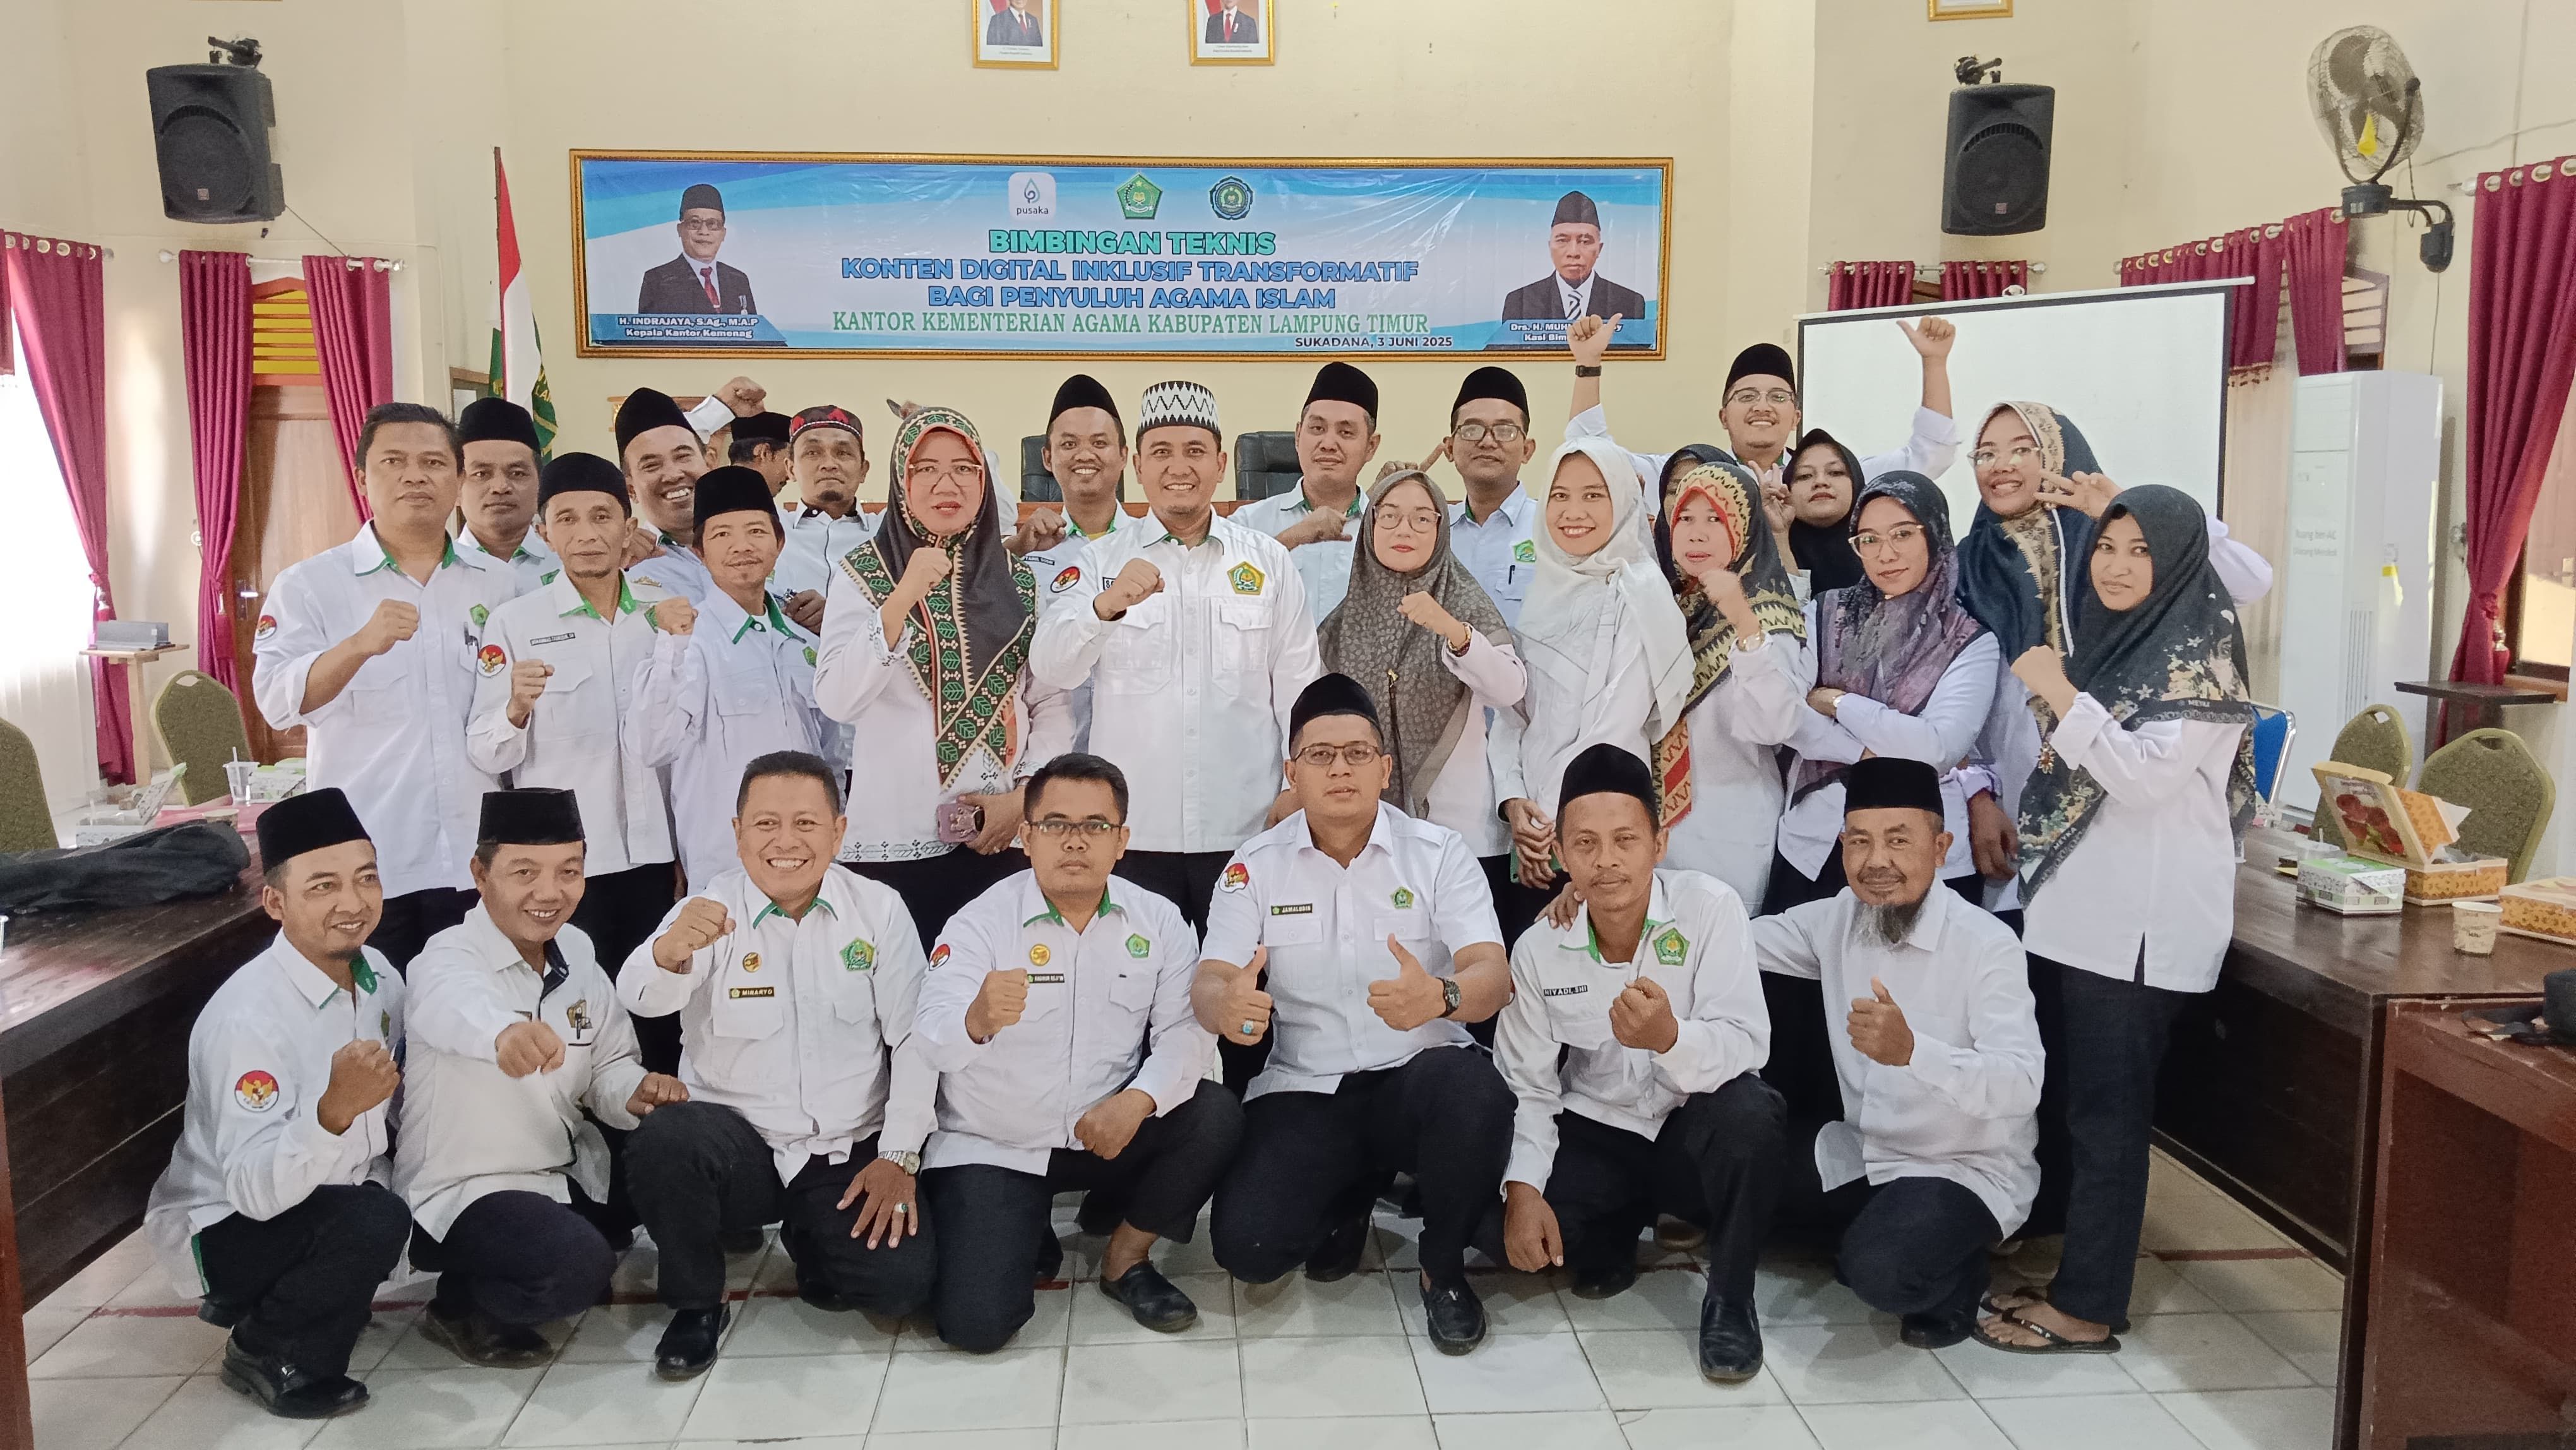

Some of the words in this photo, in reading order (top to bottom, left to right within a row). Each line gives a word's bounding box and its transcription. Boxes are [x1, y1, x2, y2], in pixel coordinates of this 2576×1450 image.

[1017, 206, 1049, 216] pusaka
[989, 229, 1161, 255] BIMBINGAN
[1166, 231, 1276, 255] TEKNIS
[842, 258, 953, 279] KONTEN
[960, 260, 1066, 280] DIGITAL
[1073, 260, 1192, 282] INKLUSIF
[1198, 261, 1419, 282] TRANSFORMATIF
[928, 285, 993, 307] BAGI
[1001, 287, 1143, 308] PENYULUH
[1150, 288, 1250, 308] AGAMA
[1256, 288, 1335, 309] ISLAM
[618, 318, 629, 326] H.
[632, 318, 695, 327] INDRAJAYA,
[833, 311, 915, 332] KANTOR
[922, 312, 1065, 332] KEMENTERIAN
[1072, 313, 1142, 333] AGAMA
[1147, 314, 1262, 333] KABUPATEN
[1269, 314, 1361, 333] LAMPUNG
[1366, 314, 1429, 333] TIMUR
[626, 328, 663, 338] Kepala
[665, 329, 701, 337] Kantor
[703, 329, 753, 339] Kemenag
[1524, 333, 1546, 342] Kasi
[1548, 333, 1568, 342] Bim
[1295, 337, 1374, 349] SUKADANA,
[1378, 337, 1385, 347] 3
[1388, 337, 1418, 347] JUNI
[1422, 337, 1452, 347] 2025
